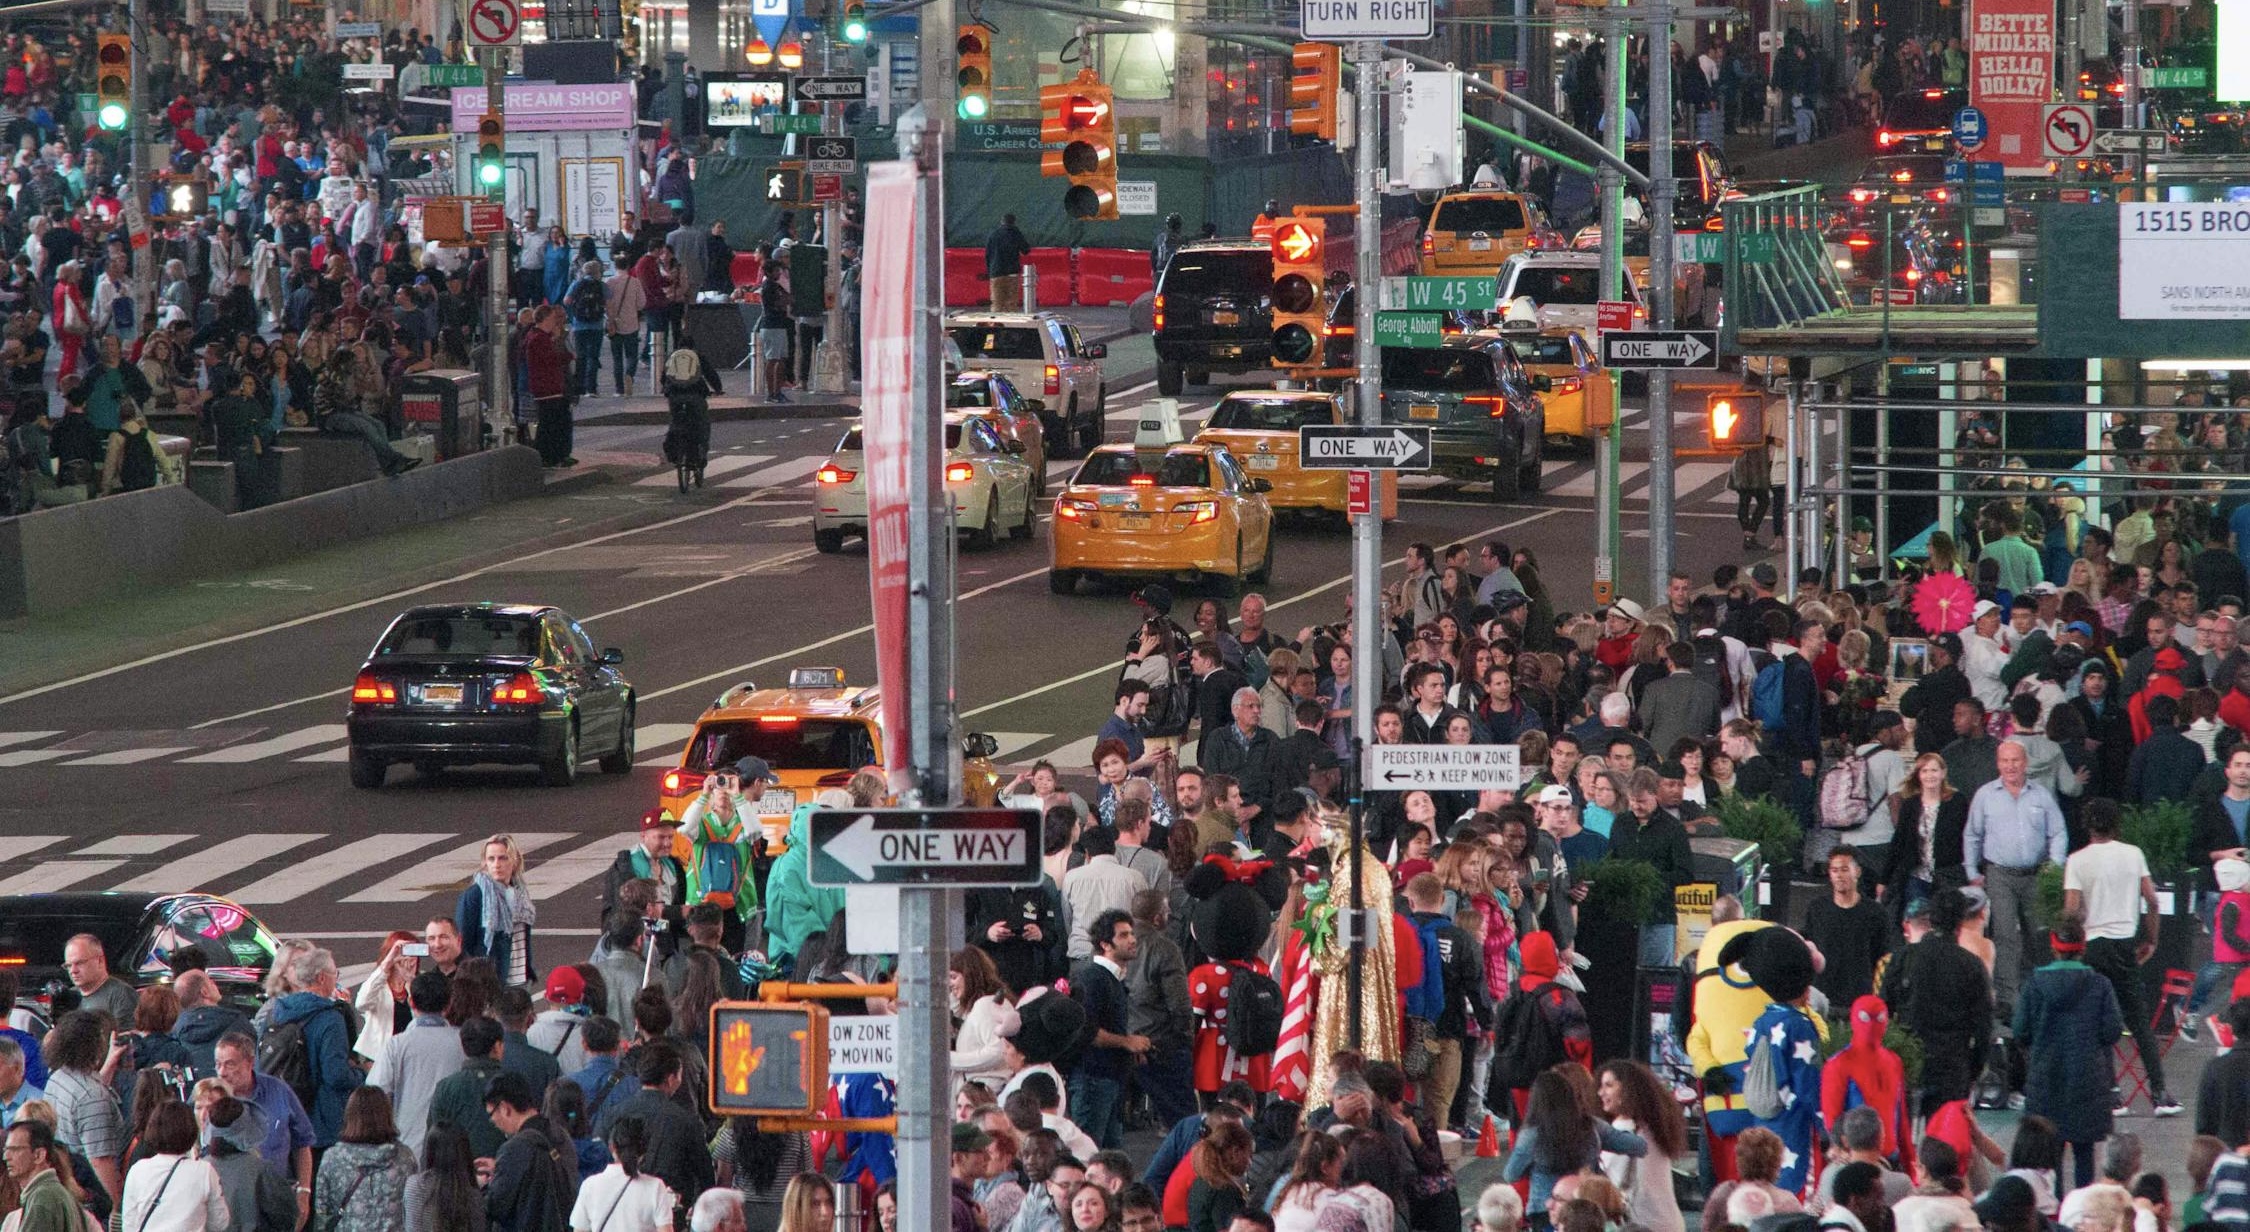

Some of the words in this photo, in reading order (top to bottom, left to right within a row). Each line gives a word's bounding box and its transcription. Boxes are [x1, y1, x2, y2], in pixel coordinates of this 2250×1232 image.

[1308, 1, 1357, 20] TURN
[1370, 1, 1427, 20] RIGHT
[1980, 13, 2048, 33] BETTE
[1974, 33, 2051, 53] MIDLER
[433, 65, 445, 84] W
[452, 65, 467, 84] 44
[1980, 56, 2047, 78] HELLO,
[1980, 76, 2047, 97] DOLLY!
[2156, 71, 2168, 85] W
[2173, 71, 2188, 85] 44
[805, 83, 825, 93] ONE
[835, 83, 858, 93] WAY
[456, 93, 488, 109] ICE
[504, 92, 563, 108] REAM
[569, 90, 623, 106] SHOP
[776, 117, 787, 131] W
[792, 117, 808, 131] 44
[974, 124, 999, 136] U.S.
[812, 161, 828, 171] BIKE
[833, 161, 851, 171] PATH
[2135, 210, 2193, 232] 1515
[2202, 210, 2250, 232] BRO
[1701, 237, 1718, 258] W
[1412, 281, 1431, 306] W
[1442, 281, 1467, 306] 45
[1477, 281, 1491, 297] St
[2195, 286, 2233, 299] NORTH
[1377, 315, 1407, 338] George
[1410, 316, 1439, 335] Abbott
[1619, 343, 1652, 357] ONE
[1666, 343, 1700, 357] WAY
[1320, 439, 1356, 455] ONE
[1373, 440, 1410, 456] WAY
[1382, 751, 1449, 764] PEDESTRIAN
[1453, 751, 1481, 764] FLOW
[1485, 751, 1513, 764] ZONE
[1441, 769, 1468, 783] KEEP
[1471, 769, 1513, 783] MOVING
[880, 834, 941, 861] ONE
[953, 834, 1016, 861] WAY
[829, 1024, 853, 1041] OW
[858, 1024, 892, 1041] ZONE
[842, 1047, 893, 1064] MOVING
